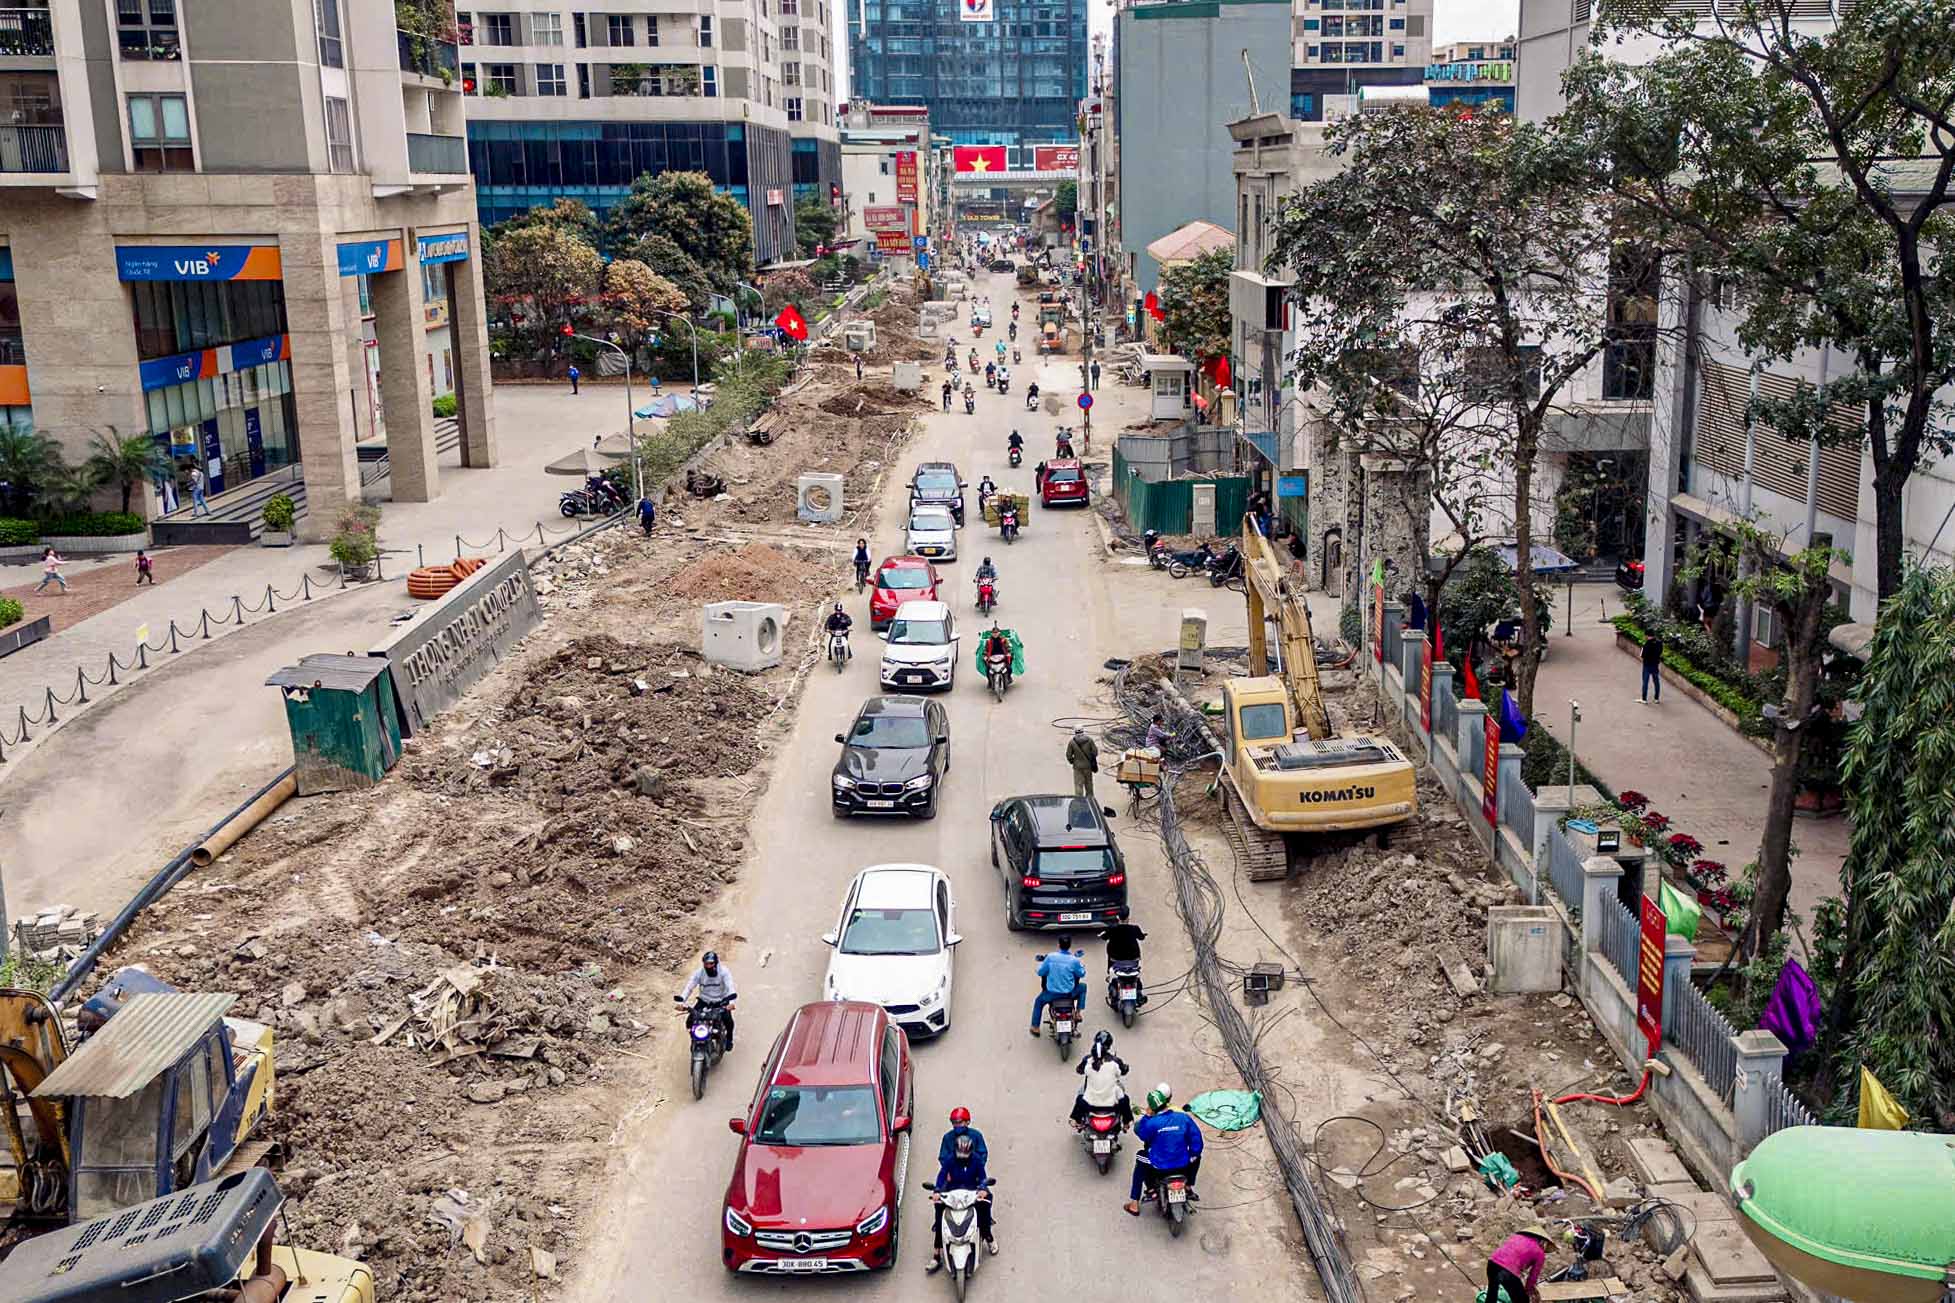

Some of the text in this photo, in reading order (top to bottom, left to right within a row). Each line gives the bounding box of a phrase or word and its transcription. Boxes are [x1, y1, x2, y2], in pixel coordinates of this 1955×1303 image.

[174, 259, 210, 275] VIB
[366, 253, 380, 269] VIB
[260, 347, 273, 360] VIB
[176, 366, 190, 379] VIB
[1299, 785, 1375, 803] KOMATSU
